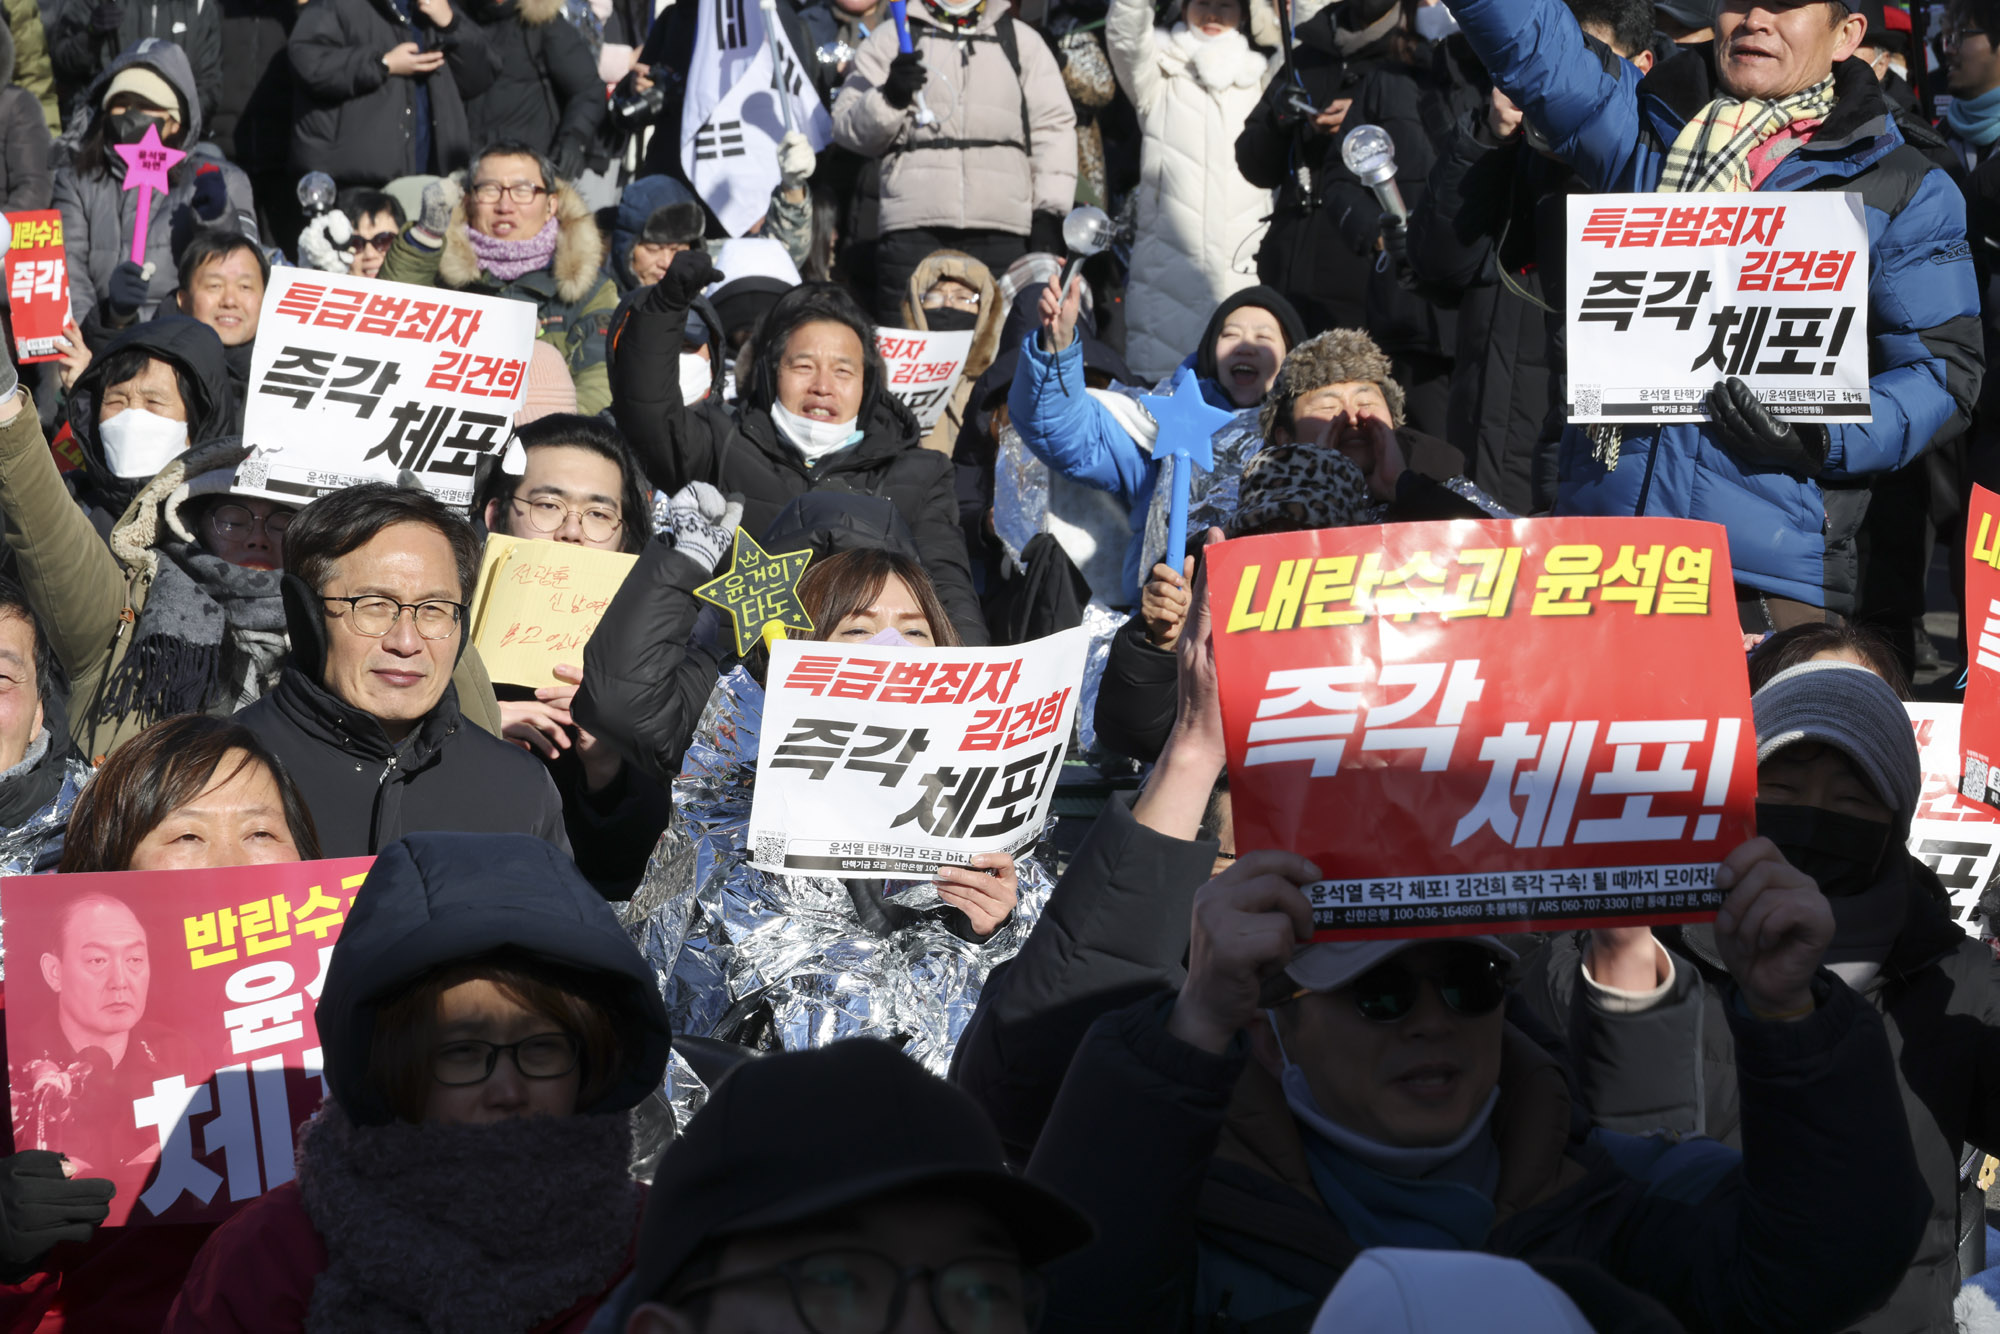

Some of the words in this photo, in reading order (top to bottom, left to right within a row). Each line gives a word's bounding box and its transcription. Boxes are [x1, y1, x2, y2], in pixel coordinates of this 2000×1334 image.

[1581, 206, 1786, 248] 특급범죄자
[11, 258, 65, 304] 즉각
[1737, 250, 1856, 291] 김건희
[275, 282, 483, 348] 특급범죄자
[1578, 270, 1712, 331] 즉각
[1690, 306, 1856, 375] 체포!
[258, 345, 401, 419] 즉각
[424, 350, 527, 400] 김건희
[891, 360, 958, 383] 김건희
[1639, 389, 1670, 401] 윤석열
[1673, 389, 1715, 401] 탄핵기
[1652, 405, 1678, 414] 탄핵기금
[1679, 405, 1693, 414] 모금
[362, 401, 514, 476] 체포
[307, 471, 338, 485] 윤석열
[741, 587, 791, 627] 타도
[1226, 547, 1522, 632] 내란수괴
[1531, 545, 1713, 616] 윤석열
[783, 655, 1023, 704] 특급범죄자
[957, 687, 1072, 751] 김건희
[1244, 659, 1485, 777] 즉각
[769, 718, 930, 787] 즉각
[889, 742, 1063, 838] 체포!
[1451, 718, 1741, 848] 체포!
[828, 842, 864, 855] 윤석열
[867, 844, 916, 858] 탄핵기금
[917, 848, 943, 860] 모금
[841, 860, 871, 869] 탄핵기금
[872, 862, 887, 870] 모금
[1310, 883, 1363, 905] 윤석열
[1368, 881, 1402, 901] 즉각
[1409, 879, 1450, 900] 체포!
[1456, 876, 1506, 898] 김건희
[1511, 874, 1544, 894] 즉각
[1549, 872, 1587, 893] 구속!
[1592, 871, 1608, 891] 될
[1612, 868, 1659, 890] 때까지
[1663, 866, 1715, 887] 모이자!
[1394, 904, 1482, 920] 100-036-164860
[1538, 899, 1559, 913] ARS
[1562, 897, 1628, 911] 060-707-3300
[183, 872, 369, 970] 반란수
[223, 944, 336, 1055] 윤
[132, 1046, 332, 1217] 체
